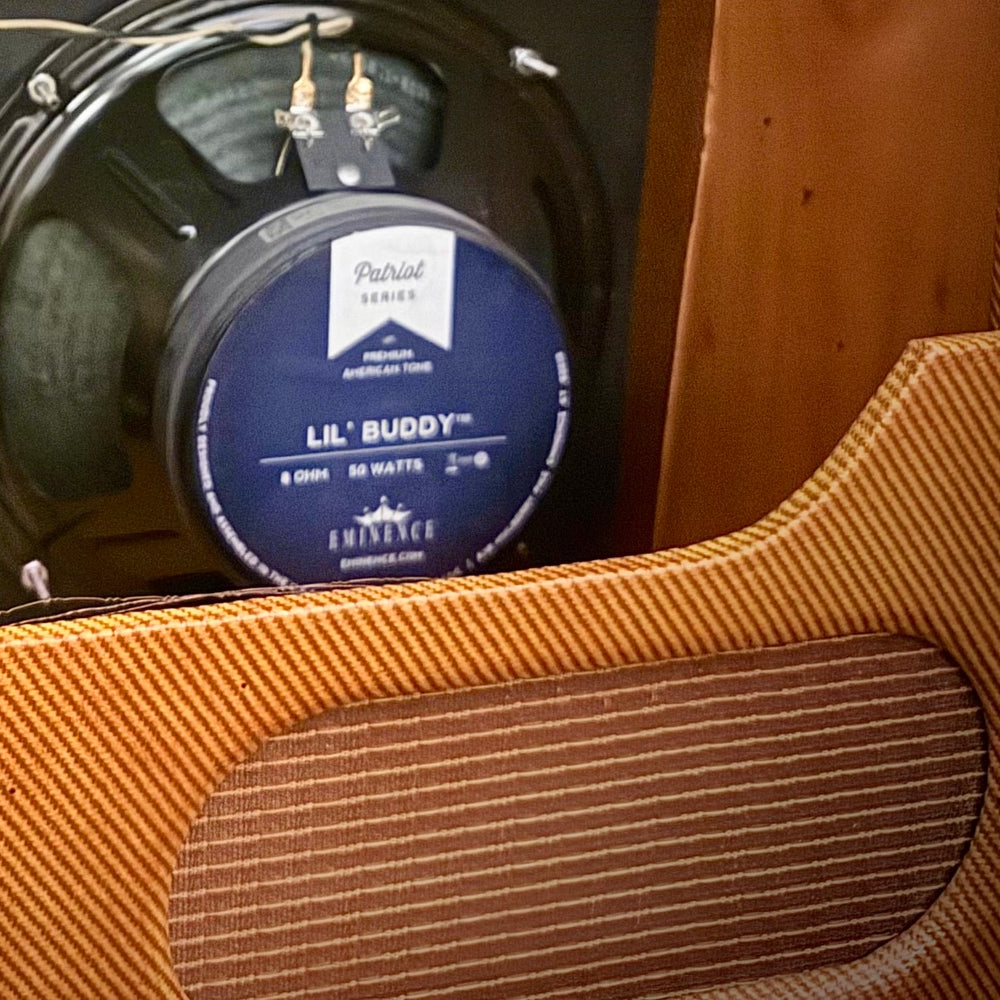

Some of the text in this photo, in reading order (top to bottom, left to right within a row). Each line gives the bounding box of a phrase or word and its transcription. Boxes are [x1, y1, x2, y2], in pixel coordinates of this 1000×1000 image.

[354, 258, 425, 286] Patriot
[361, 289, 416, 304] SERIES
[306, 420, 355, 449] LIL'
[293, 467, 331, 486] OHM
[370, 457, 425, 477] WATTS
[328, 518, 436, 552] EMINENCE
